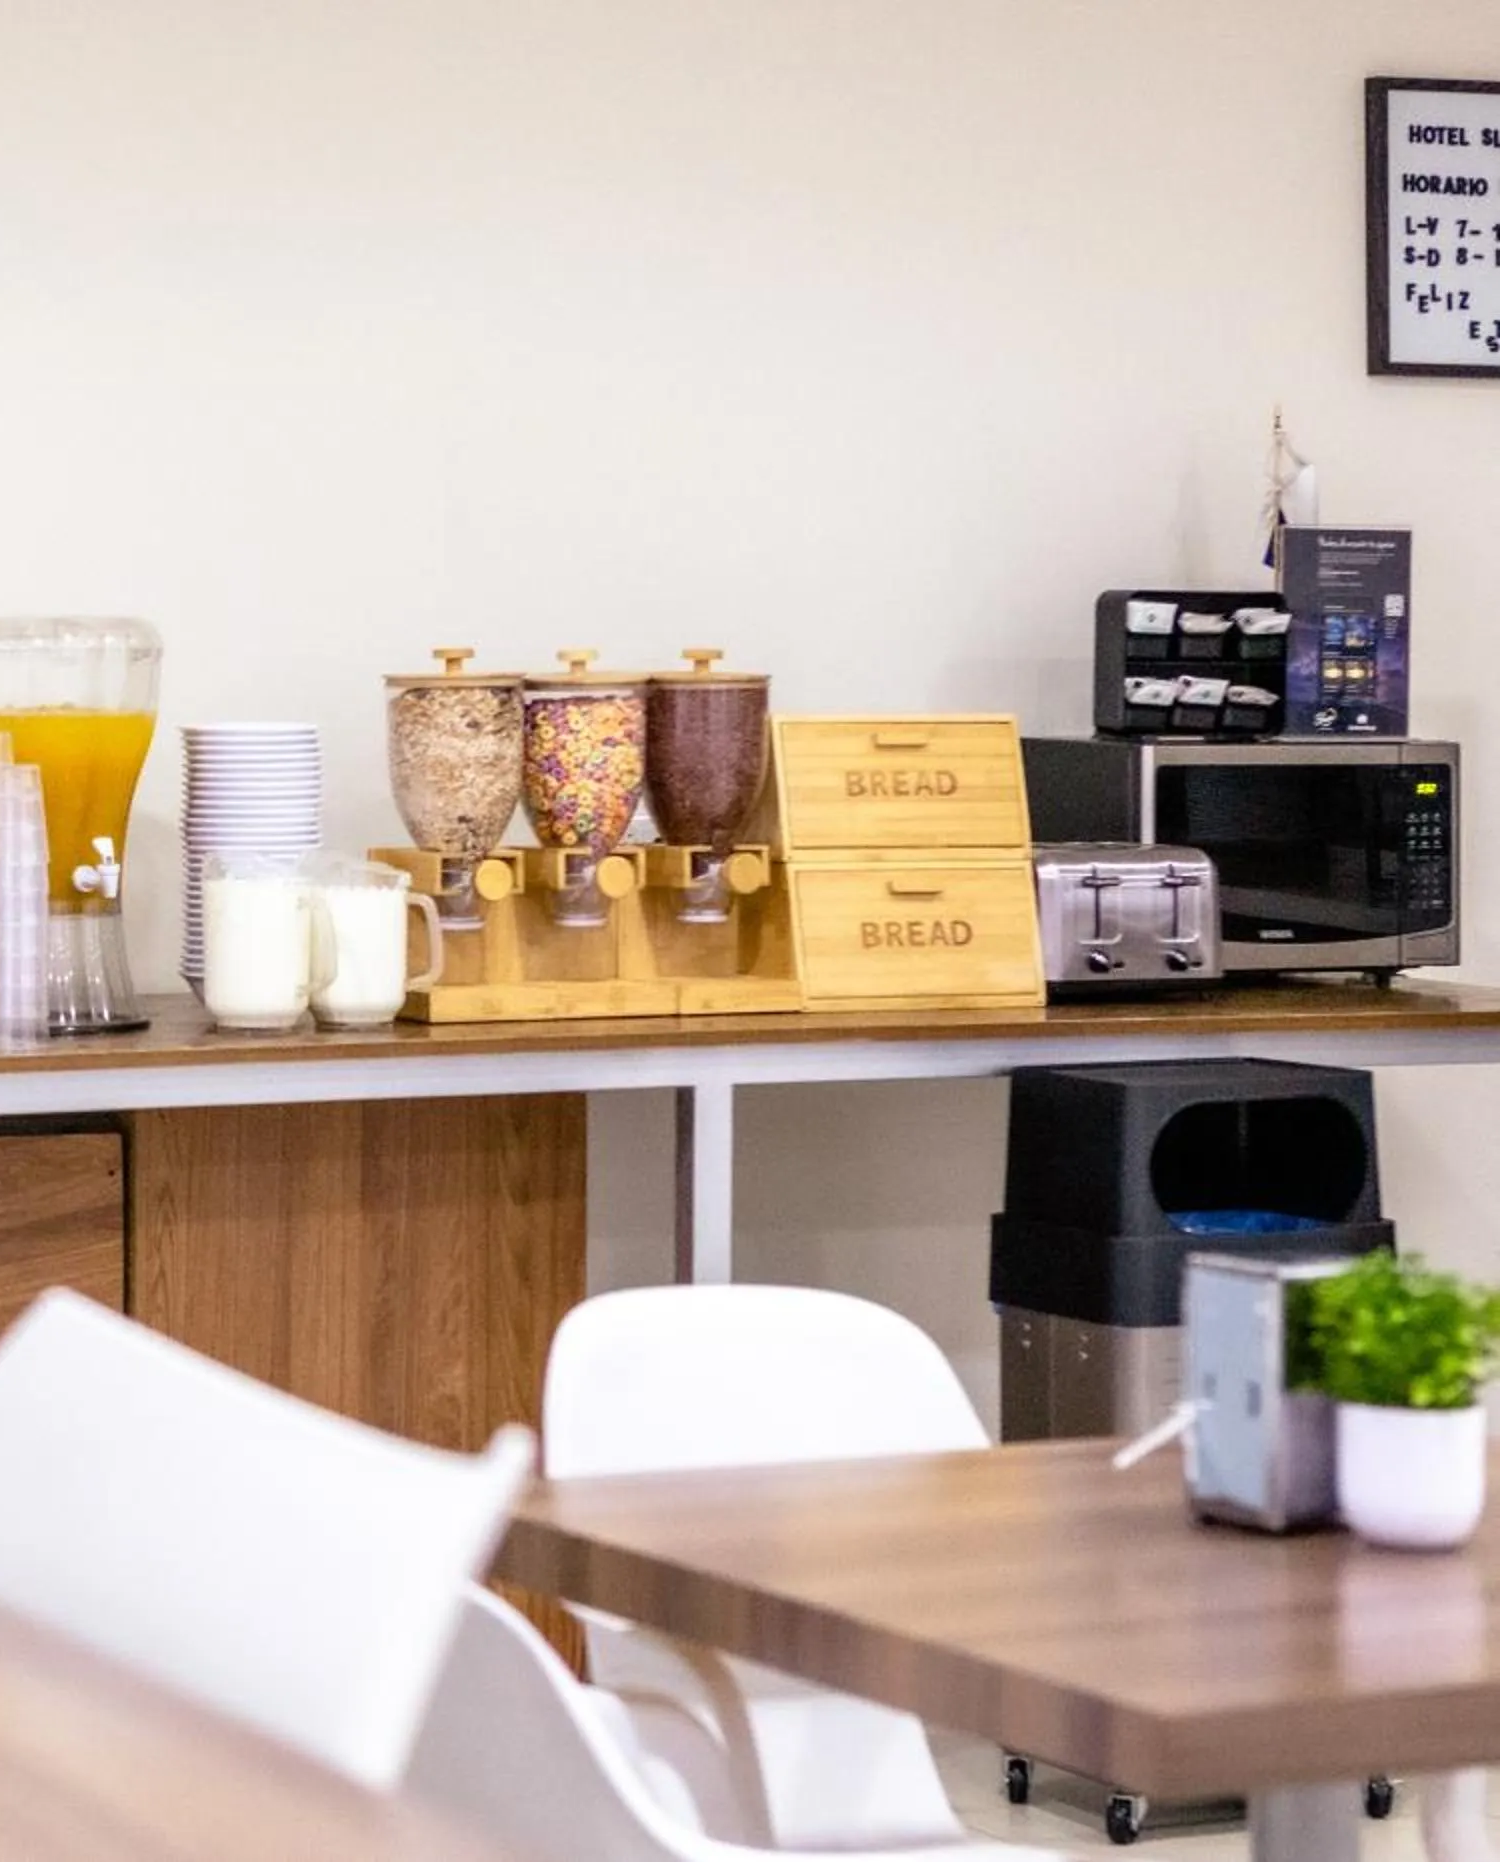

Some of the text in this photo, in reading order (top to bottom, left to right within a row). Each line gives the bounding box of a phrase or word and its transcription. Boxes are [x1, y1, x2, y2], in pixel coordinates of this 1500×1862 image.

[1408, 124, 1470, 146] HOTEL
[1402, 173, 1488, 197] HORARIO
[1405, 216, 1439, 236] L-V
[1404, 246, 1441, 267] S-D
[844, 769, 959, 797] BREAD
[860, 920, 974, 950] BREAD
